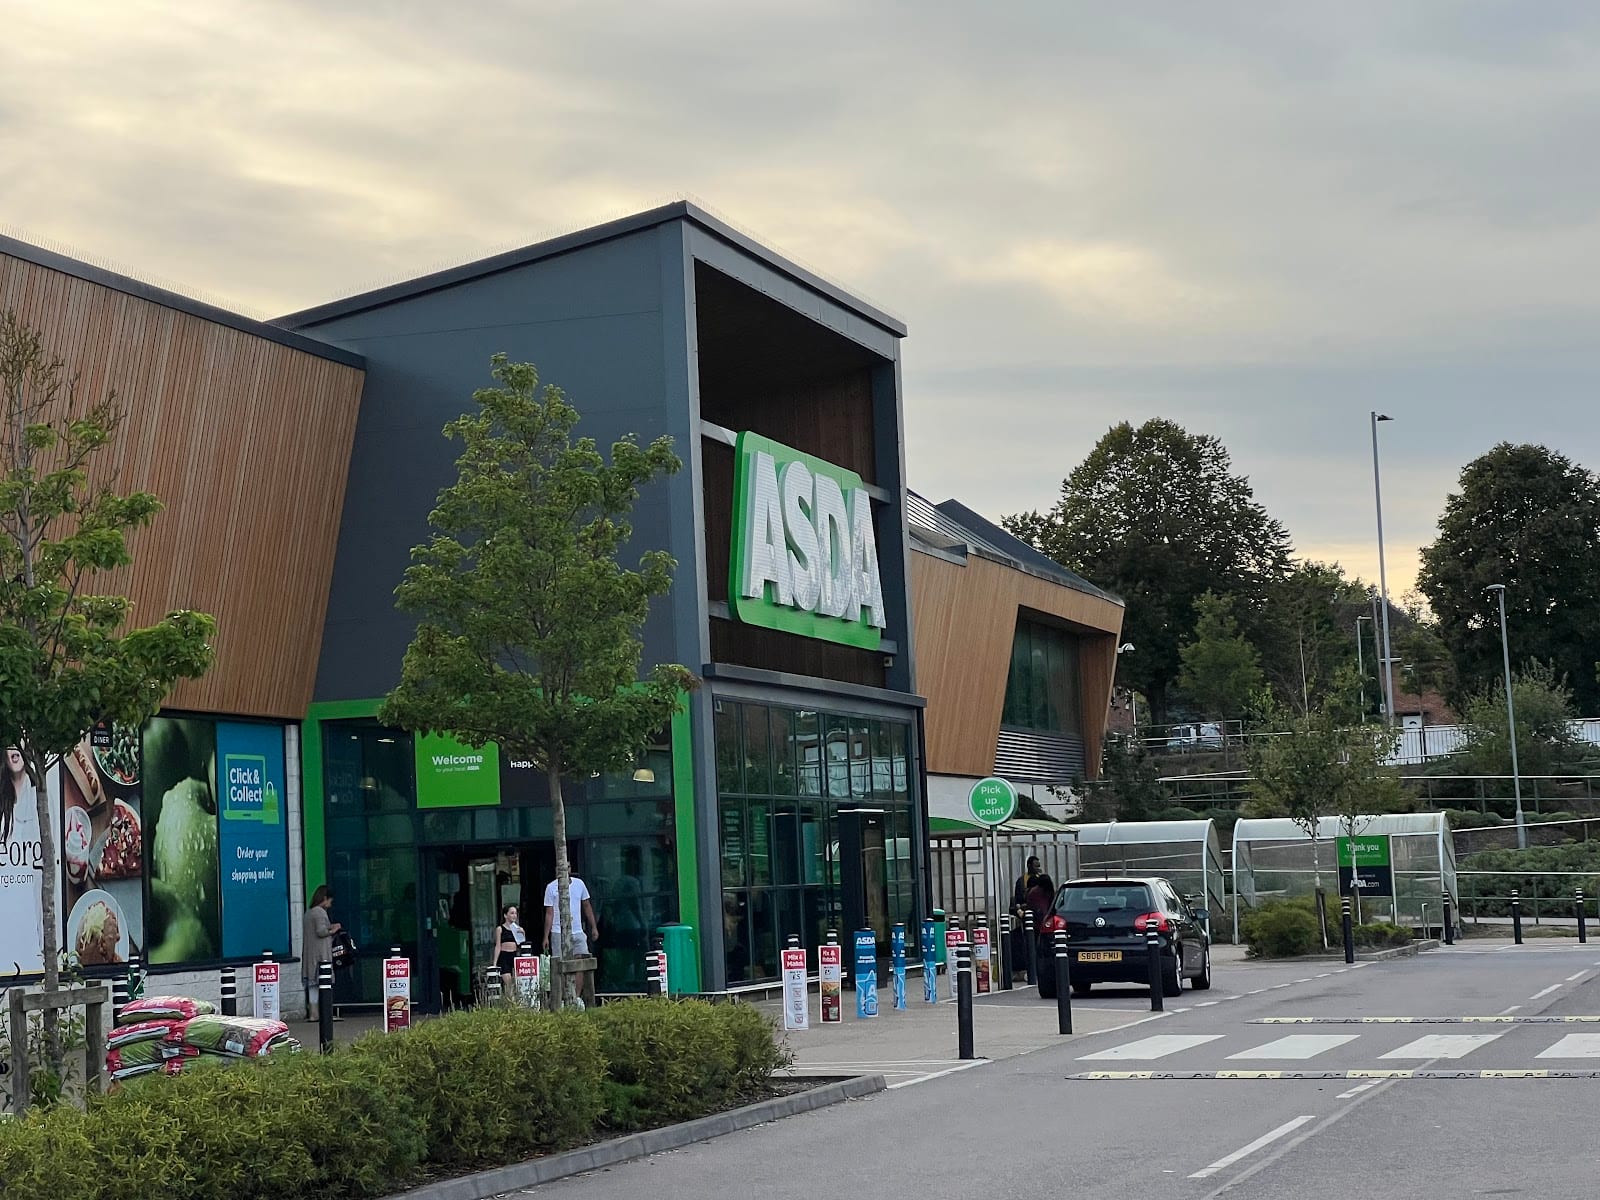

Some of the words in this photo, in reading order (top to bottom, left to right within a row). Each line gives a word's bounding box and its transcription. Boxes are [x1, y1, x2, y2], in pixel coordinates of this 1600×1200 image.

[742, 451, 886, 629] ASDA
[432, 755, 483, 765] Welcome
[231, 786, 263, 802] Collect
[981, 786, 1001, 794] Pick
[980, 807, 1005, 817] point
[1346, 843, 1365, 852] Tank
[1367, 844, 1379, 852] you
[237, 846, 254, 859] Order
[255, 849, 269, 861] your
[231, 868, 258, 883] shopping
[258, 867, 275, 880] online
[1349, 880, 1380, 888] ADA.com
[856, 937, 876, 946] ASDA
[1103, 952, 1119, 960] FMU
